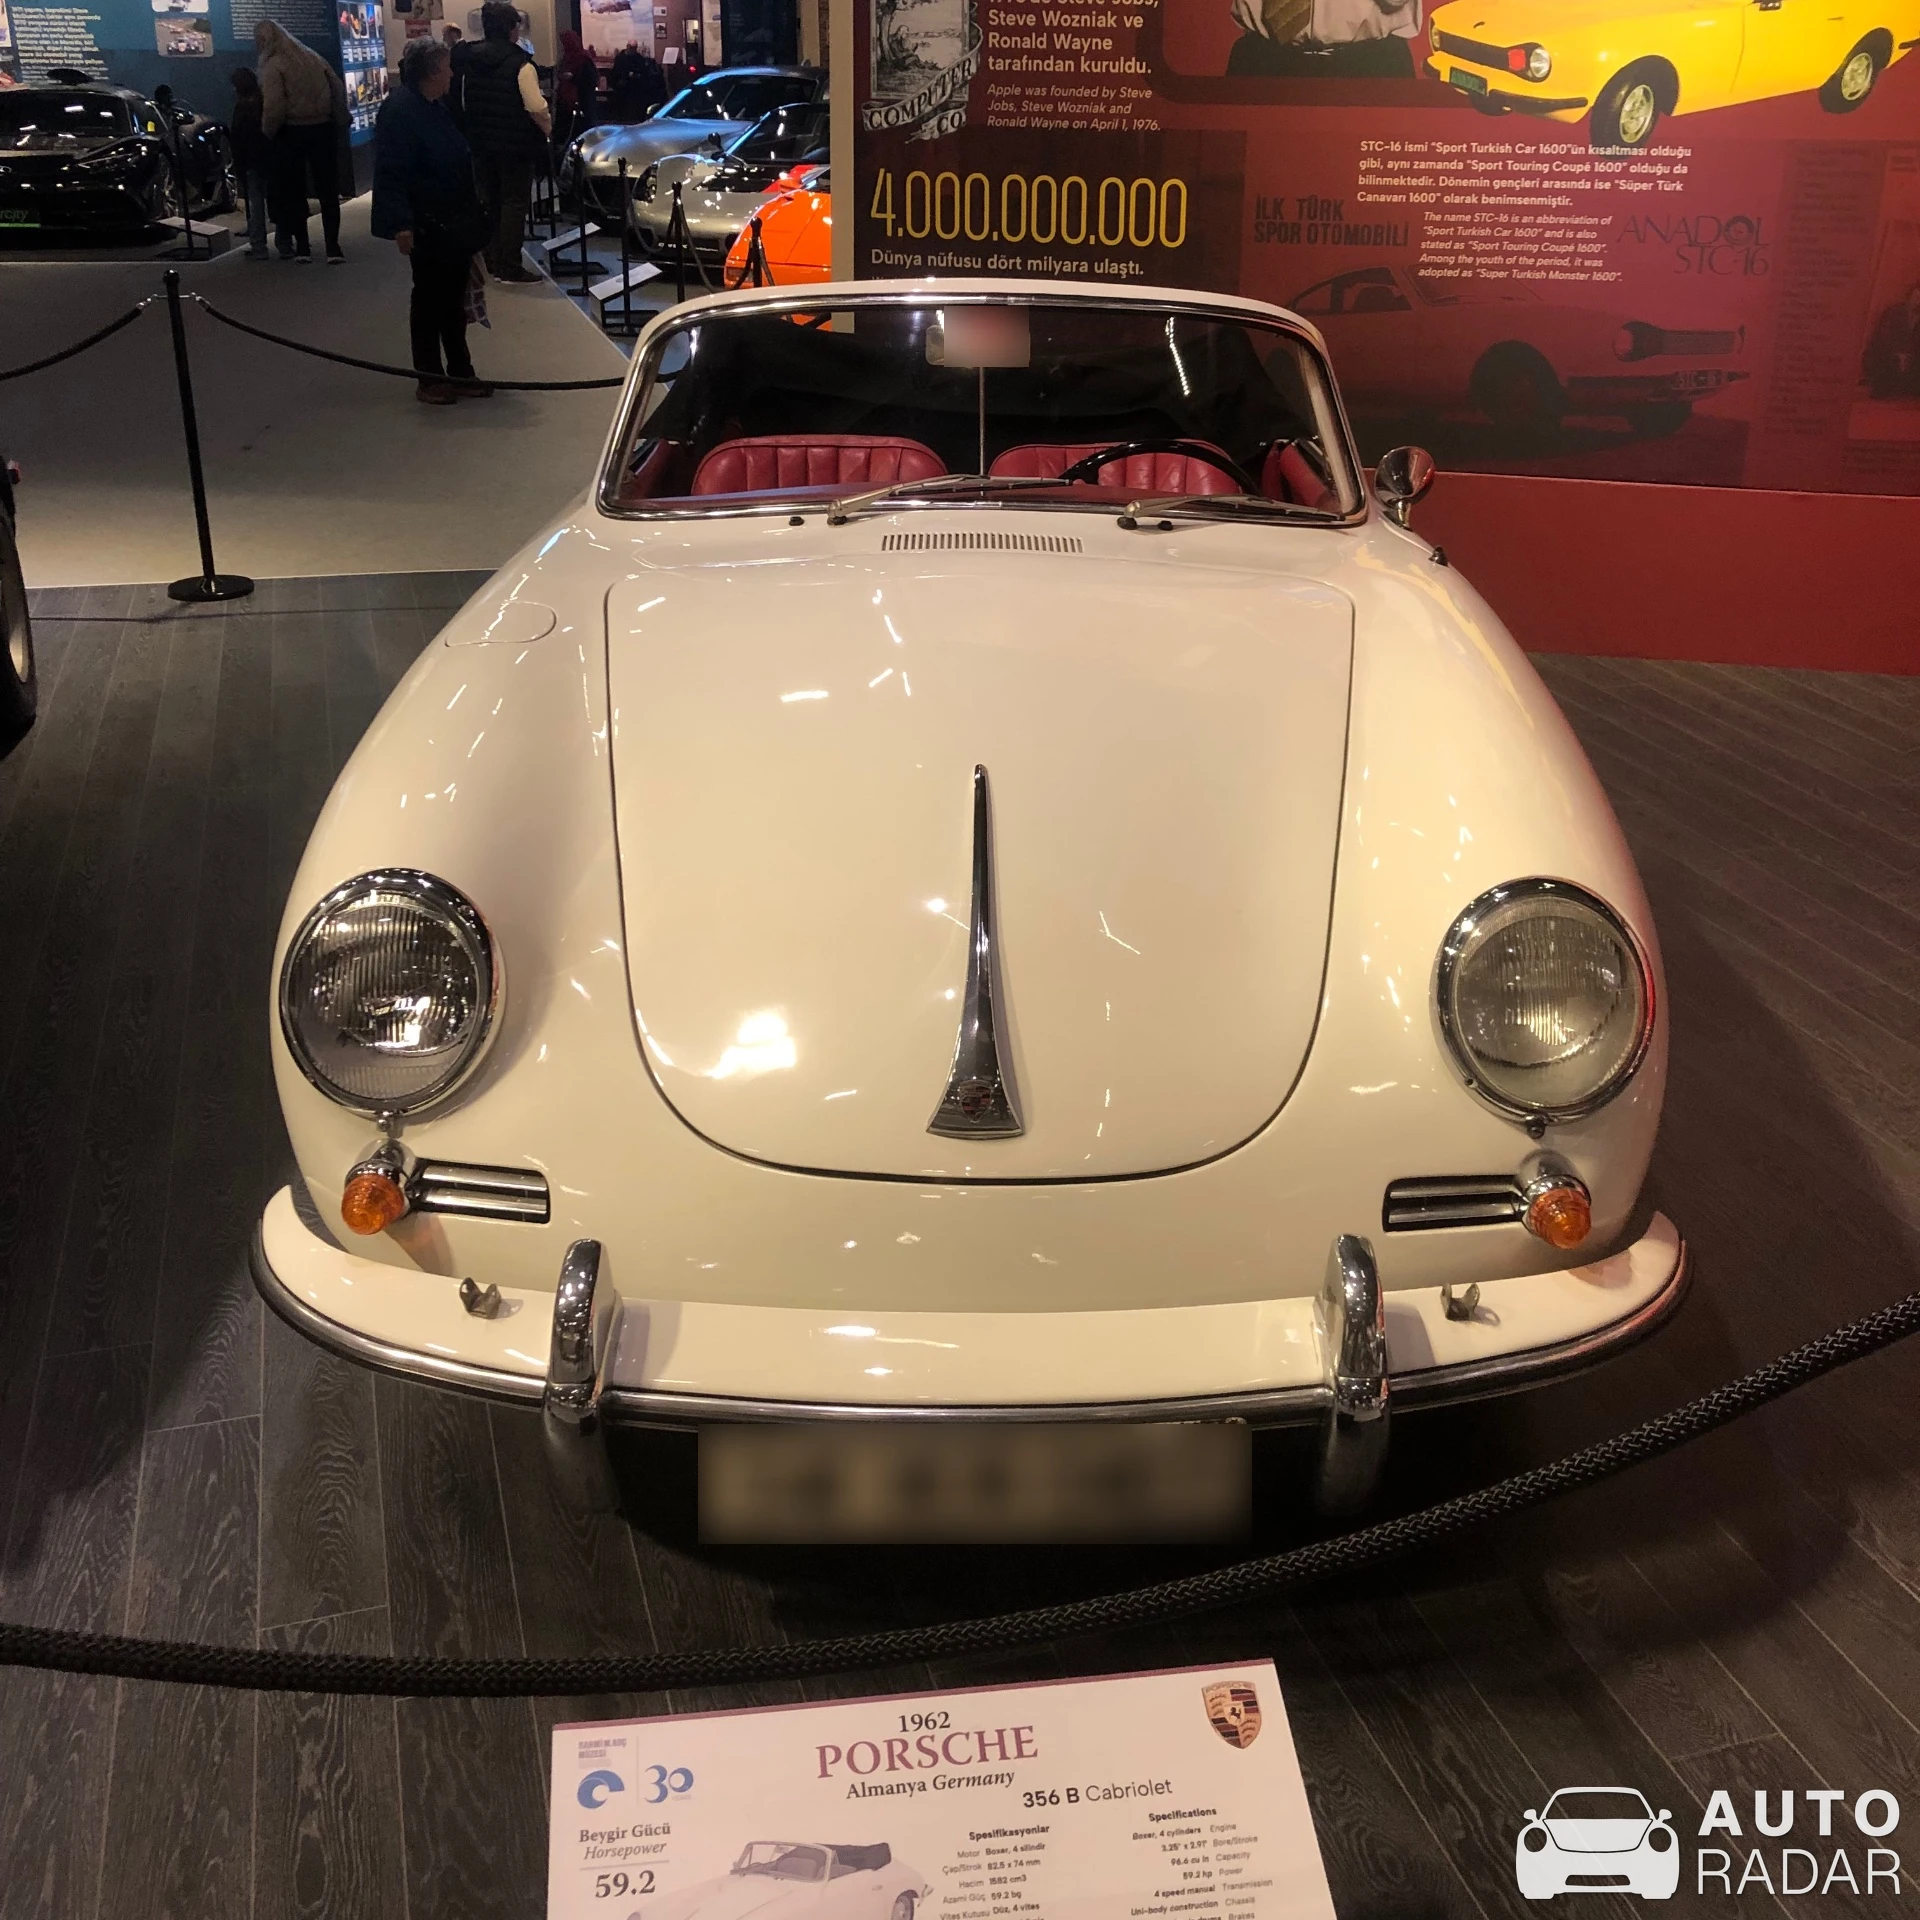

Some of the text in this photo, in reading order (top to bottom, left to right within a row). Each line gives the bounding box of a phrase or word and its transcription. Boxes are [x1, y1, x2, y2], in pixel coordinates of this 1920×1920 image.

[988, 9, 1144, 28] Steve Wozniak ve
[988, 32, 1112, 54] Ronald Wayne
[988, 55, 1151, 74] tarafından kuruldu.
[869, 57, 972, 129] COMPUTER
[987, 84, 1152, 100] Apple was founded by Steve
[988, 100, 1132, 114] Jobs, Steve Wozniak and
[987, 116, 1161, 132] Ronald Wayne on April 1, 1976.
[1360, 141, 1401, 152] STC-16
[1404, 142, 1428, 152] ismi
[1471, 142, 1512, 153] Turkish
[1515, 143, 1536, 154] Car
[1588, 144, 1648, 156] kısaltması
[1650, 146, 1692, 159] olduğu
[1359, 158, 1384, 170] gibi,
[1387, 161, 1410, 171] aynı
[1412, 160, 1463, 170] zamanda
[1506, 160, 1549, 174] Touring
[1629, 163, 1670, 176] olduğu
[1673, 164, 1688, 174] da
[1358, 175, 1436, 186] bilinmektedir.
[1439, 176, 1489, 187] Dönemin
[1493, 177, 1540, 190] gençleri
[1542, 179, 1591, 189] arasında
[1594, 180, 1611, 189] ise
[1656, 180, 1683, 191] Türk
[871, 168, 1188, 248] 4.000.000.000
[1255, 193, 1344, 221] İLK TÜRK
[1357, 192, 1406, 203] Canavarı
[1443, 193, 1478, 204] olarak
[1481, 194, 1573, 208] benimsenmiştir.
[1424, 212, 1441, 222] The
[1444, 214, 1471, 222] name
[1473, 213, 1508, 223] STC-16
[1511, 213, 1519, 223] is
[1536, 215, 1599, 225] abbreviation
[1601, 216, 1613, 225] of
[1254, 221, 1409, 246] SPOR OTOMOBİLİ
[1456, 226, 1491, 236] Turkish
[1494, 227, 1512, 237] Car
[1544, 228, 1563, 238] and
[1565, 229, 1573, 238] is
[1576, 229, 1597, 239] also
[1616, 215, 1770, 247] ANADOL
[1420, 240, 1451, 250] stated
[1453, 242, 1465, 250] as
[1502, 241, 1538, 253] Touring
[871, 249, 1144, 279] Dünya nüfusu dört milyara ulaştı.
[1419, 254, 1603, 267] Among the youth of the period, it was
[1418, 268, 1460, 278] adopted
[1461, 270, 1473, 278] as
[1512, 269, 1546, 279] Turkish
[1549, 270, 1590, 280] Monster
[898, 1711, 951, 1733] 1962
[815, 1725, 1038, 1779] PORSCHE
[645, 1765, 694, 1803] 30
[846, 1771, 1015, 1800] Almanya Germany
[1022, 1779, 1173, 1808] 356 B Cabriolet
[1148, 1808, 1217, 1823] Specifications
[579, 1823, 671, 1844] Beygir Gücü
[969, 1825, 1050, 1842] Spesifikasyonlar
[1132, 1831, 1157, 1841] Boxer,
[1166, 1826, 1202, 1838] cylinders
[1210, 1823, 1237, 1833] Engine
[584, 1843, 667, 1860] Horsepower
[957, 1850, 980, 1859] Motor
[985, 1847, 1011, 1856] Boxer,
[1020, 1842, 1046, 1852] silindir
[1171, 1857, 1189, 1866] 96.6
[1202, 1855, 1209, 1863] in
[1216, 1851, 1251, 1862] Capacity
[987, 1861, 1005, 1870] 82.5
[1013, 1859, 1024, 1867] 74
[1183, 1867, 1243, 1880] 59.2 hp Power
[595, 1870, 656, 1898] 59.2
[959, 1874, 1027, 1889] Hacim 1582 cm3
[1162, 1888, 1185, 1899] speed
[1187, 1884, 1216, 1895] manual
[1222, 1879, 1273, 1891] Transmission
[942, 1891, 1022, 1904] Azami Güç 59.2 bg
[1131, 1897, 1255, 1916] Uni-body construction Chassis
[962, 1903, 1040, 1919] Kutusu Düz, 4 vites
